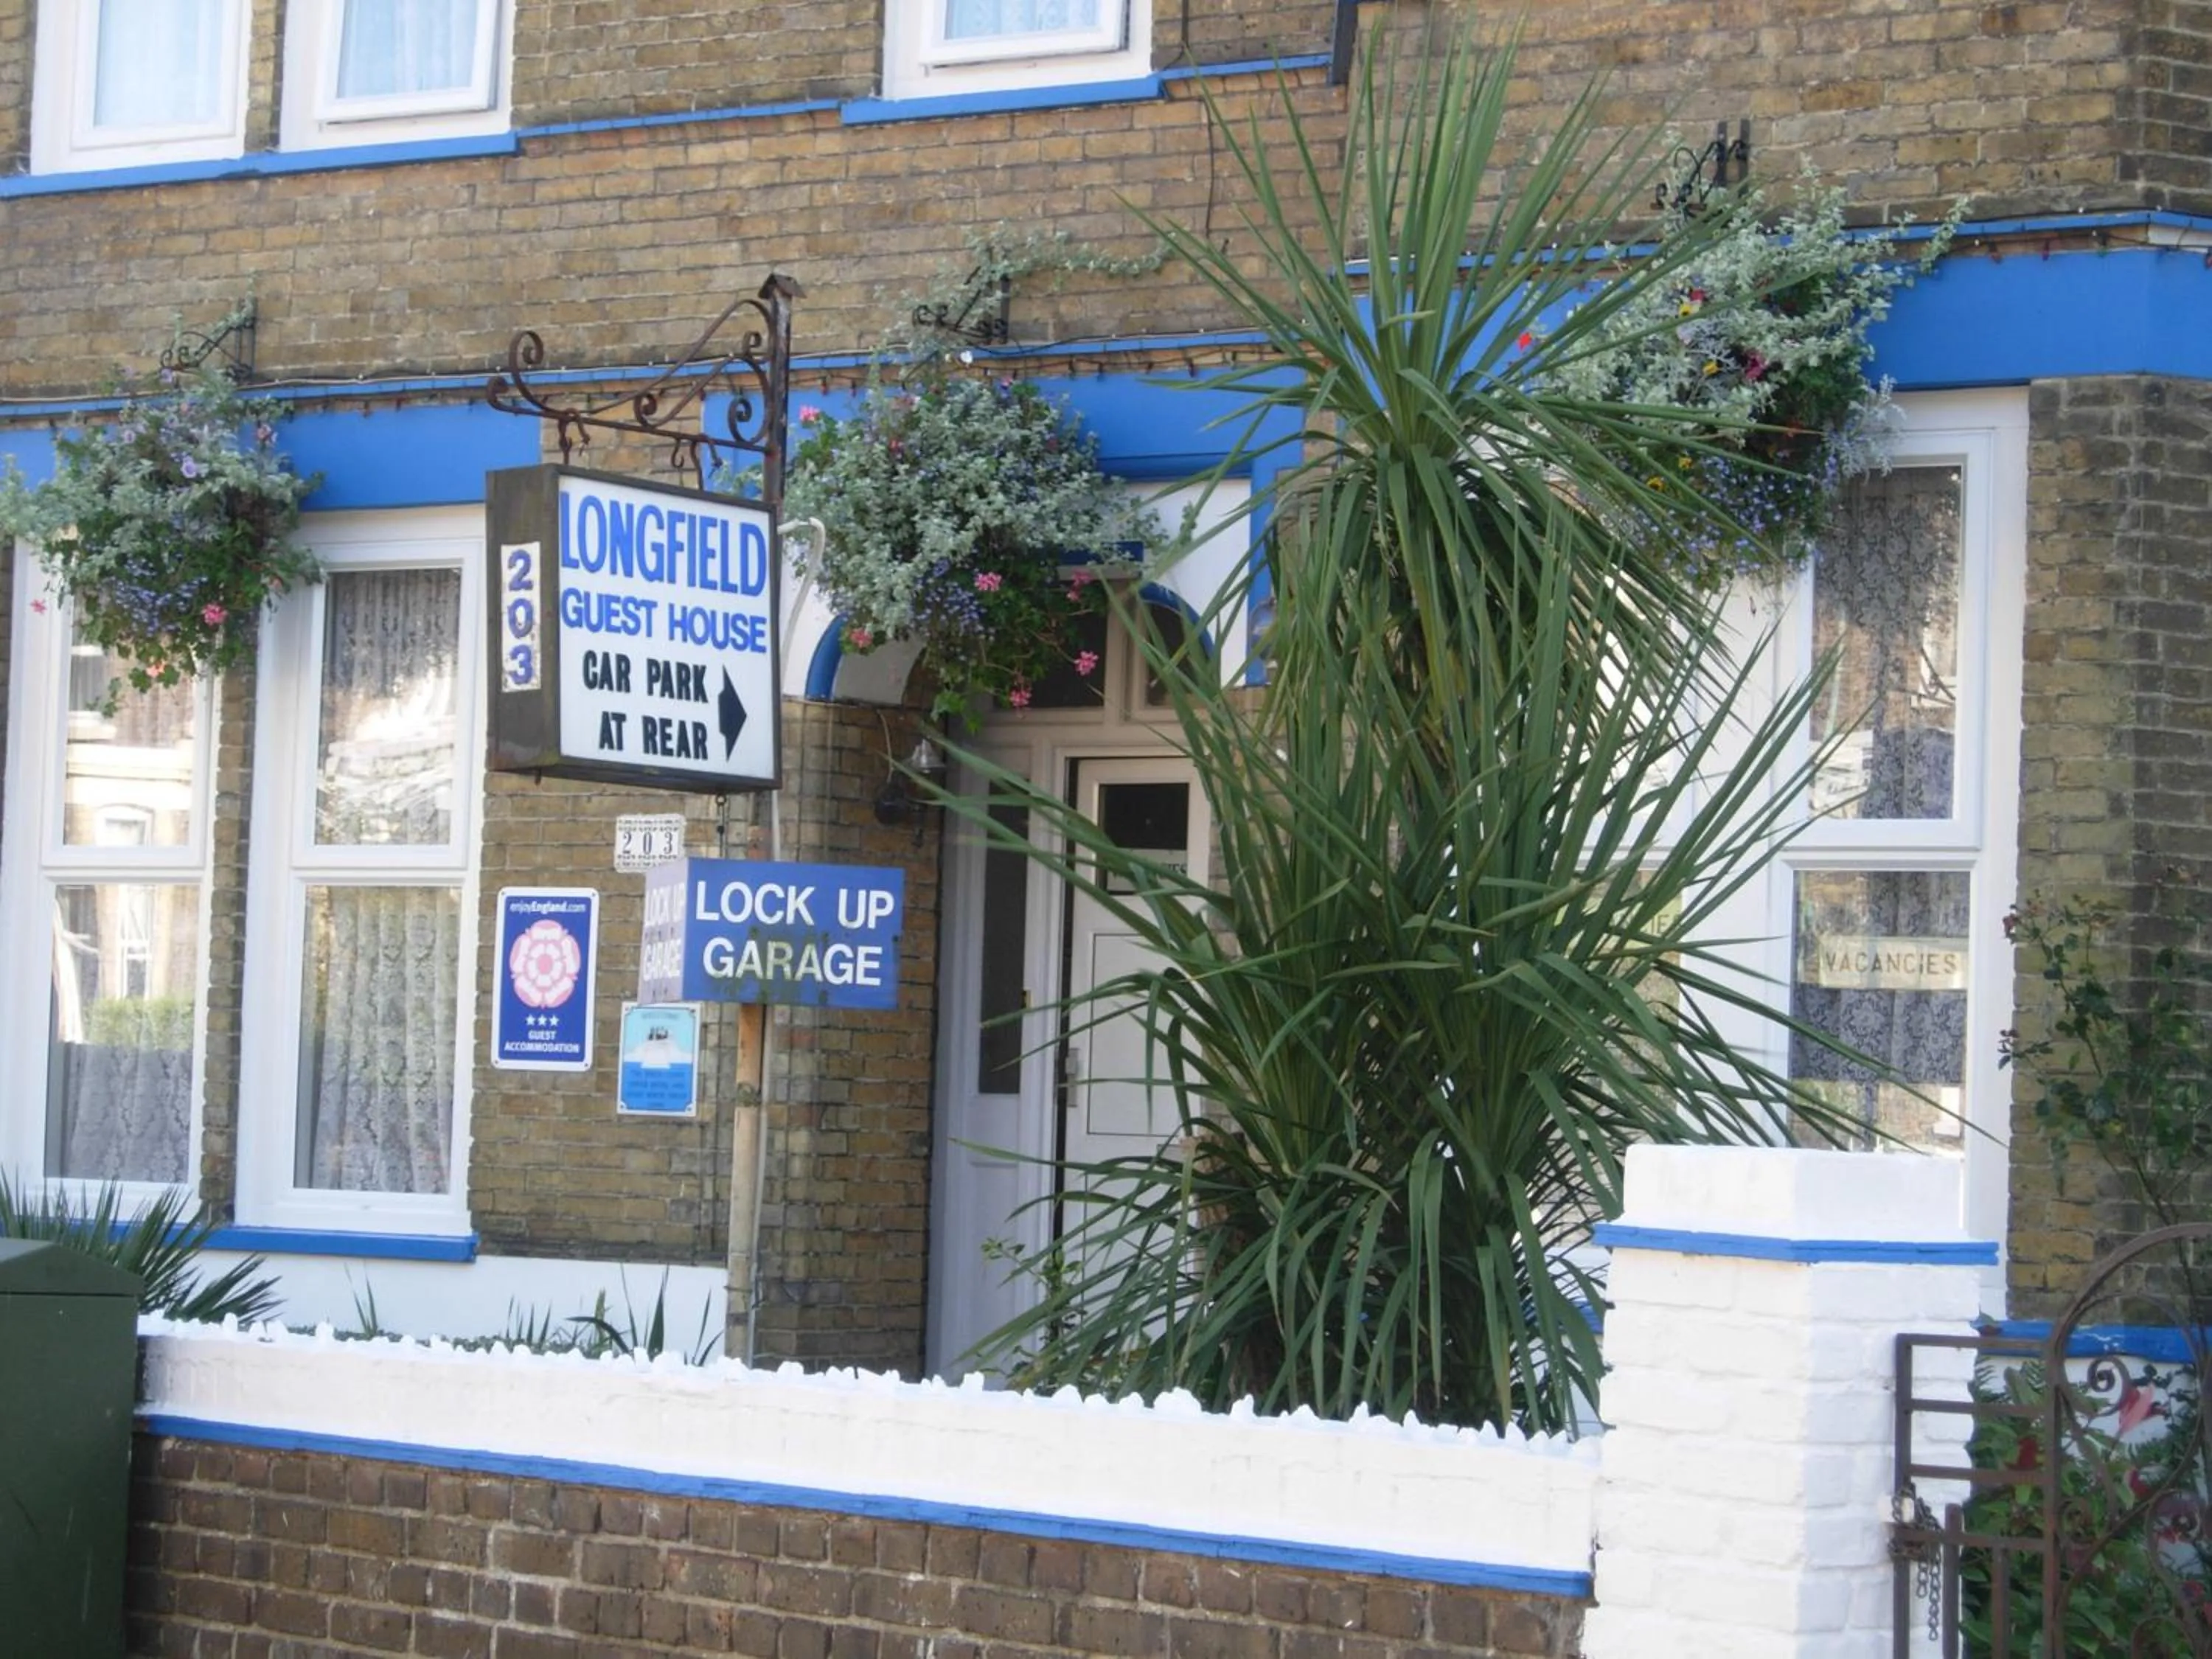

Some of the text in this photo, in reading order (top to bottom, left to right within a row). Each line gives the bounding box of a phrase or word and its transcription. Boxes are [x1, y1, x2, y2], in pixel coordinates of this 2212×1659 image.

[559, 490, 768, 598] LONGFIELD
[507, 549, 535, 686] 203
[560, 588, 768, 654] GUEST HOUSE
[582, 649, 709, 704] CAR PARK
[598, 711, 709, 760] AT REAR
[622, 830, 673, 855] 203
[695, 880, 894, 930] LOCK UP
[702, 936, 883, 987] GARAGE
[1824, 951, 1958, 975] VACANCIES
[504, 1041, 580, 1054] ACCOMMODATION
[528, 1030, 557, 1040] GUEST
